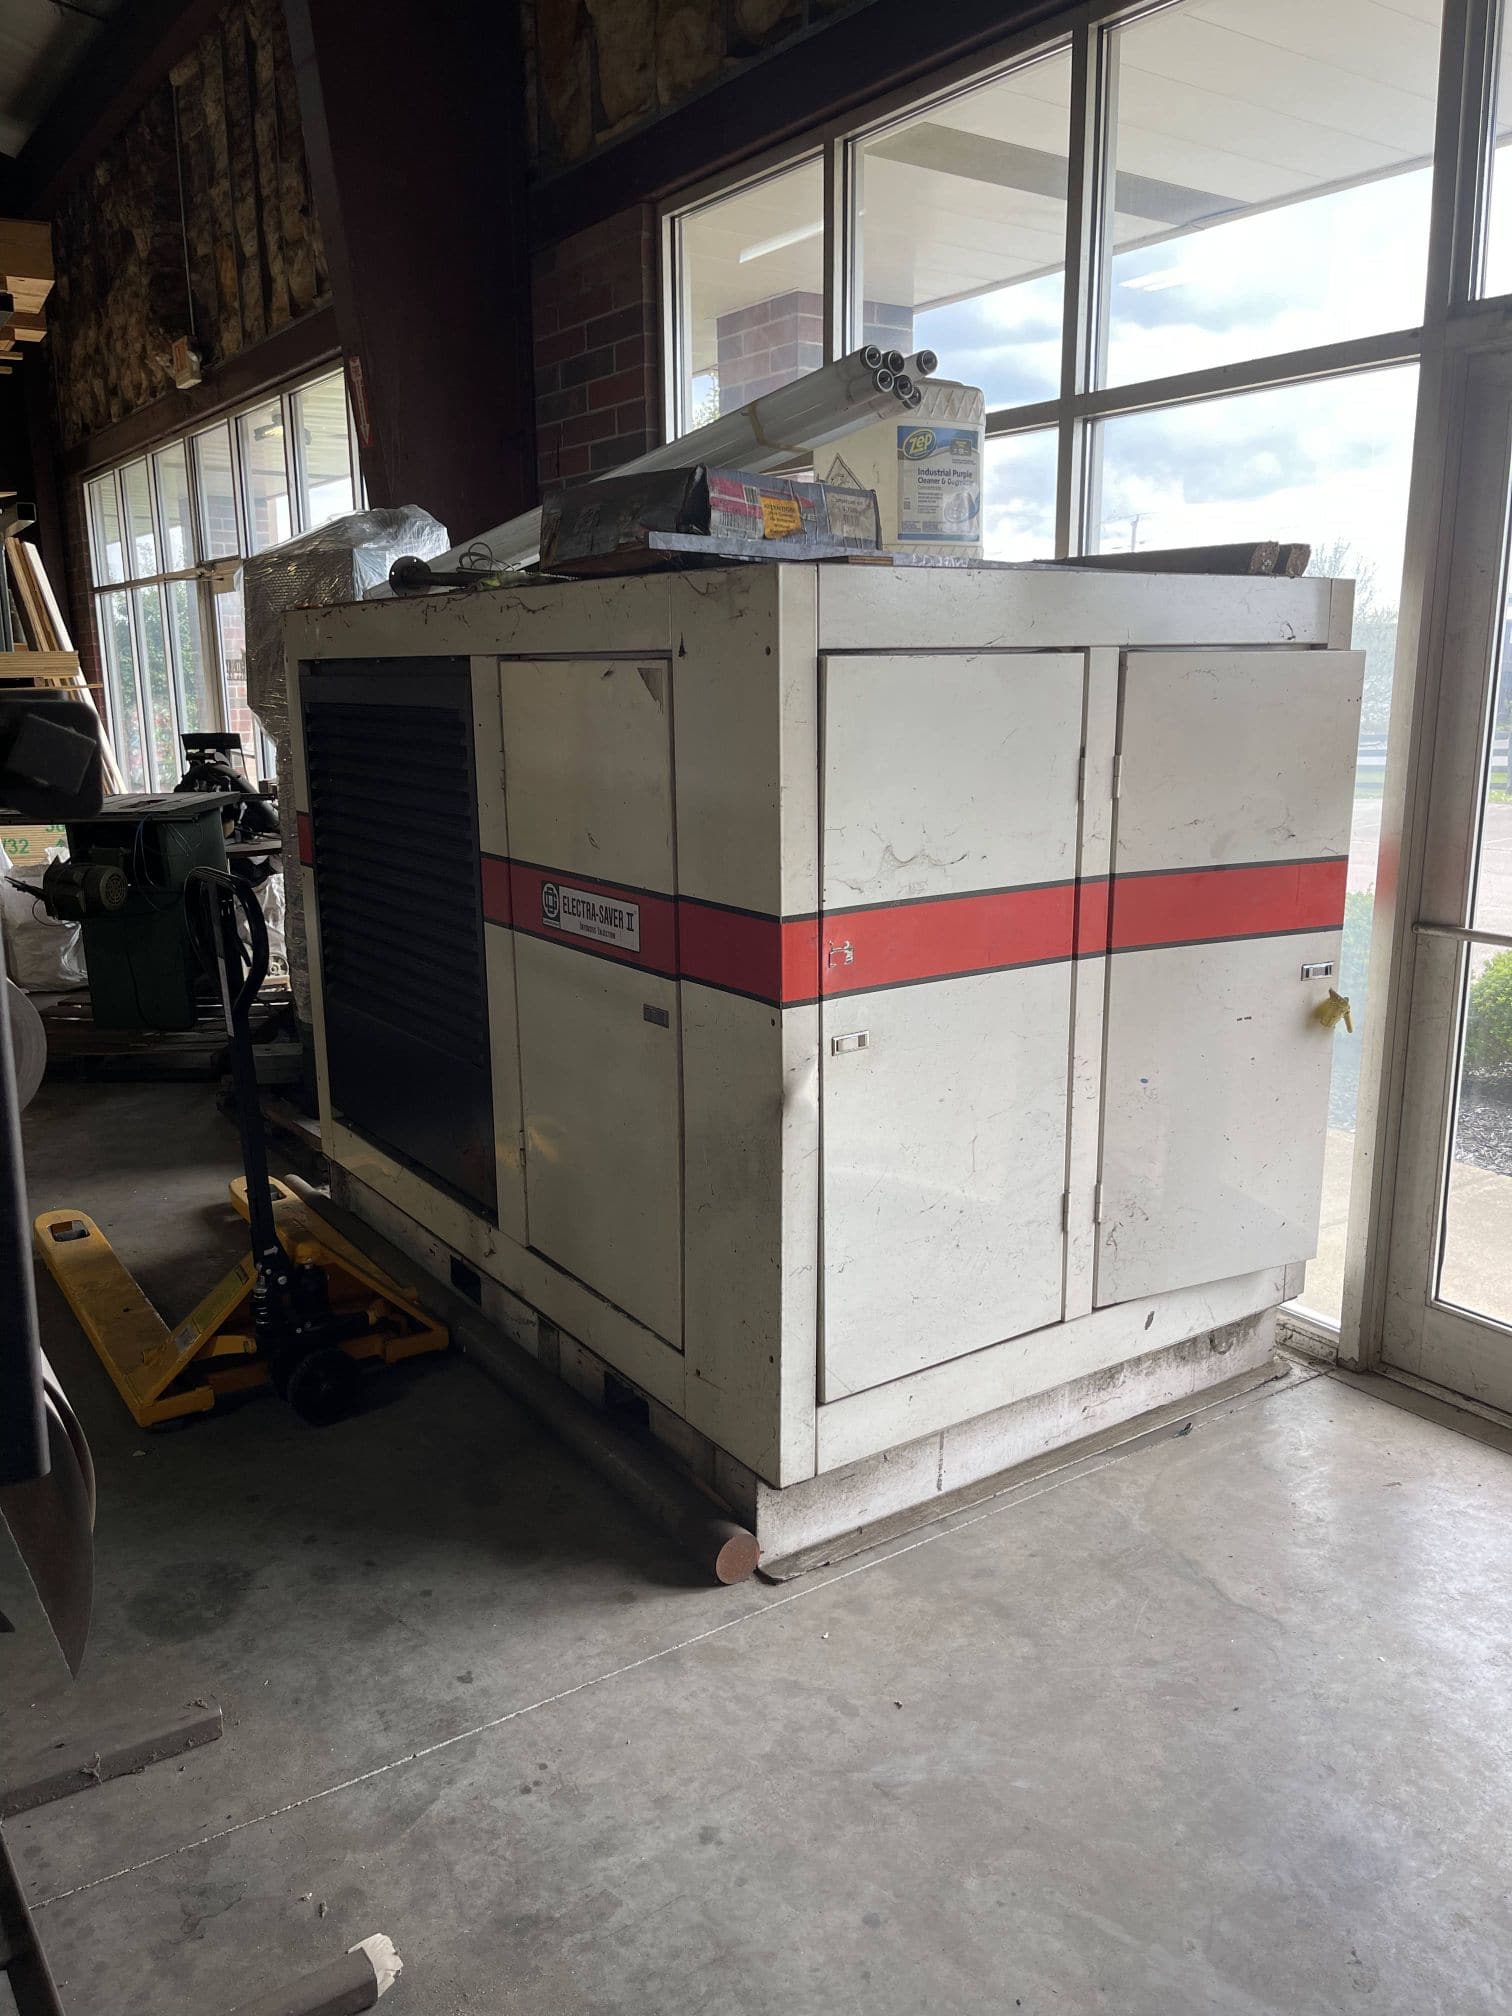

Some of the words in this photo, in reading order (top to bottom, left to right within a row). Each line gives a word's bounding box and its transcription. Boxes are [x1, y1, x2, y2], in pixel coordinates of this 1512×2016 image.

[917, 467, 951, 477] Industrial
[952, 469, 973, 479] Purple
[941, 477, 946, 485] &
[562, 895, 624, 929] ELECTRA-SAVER
